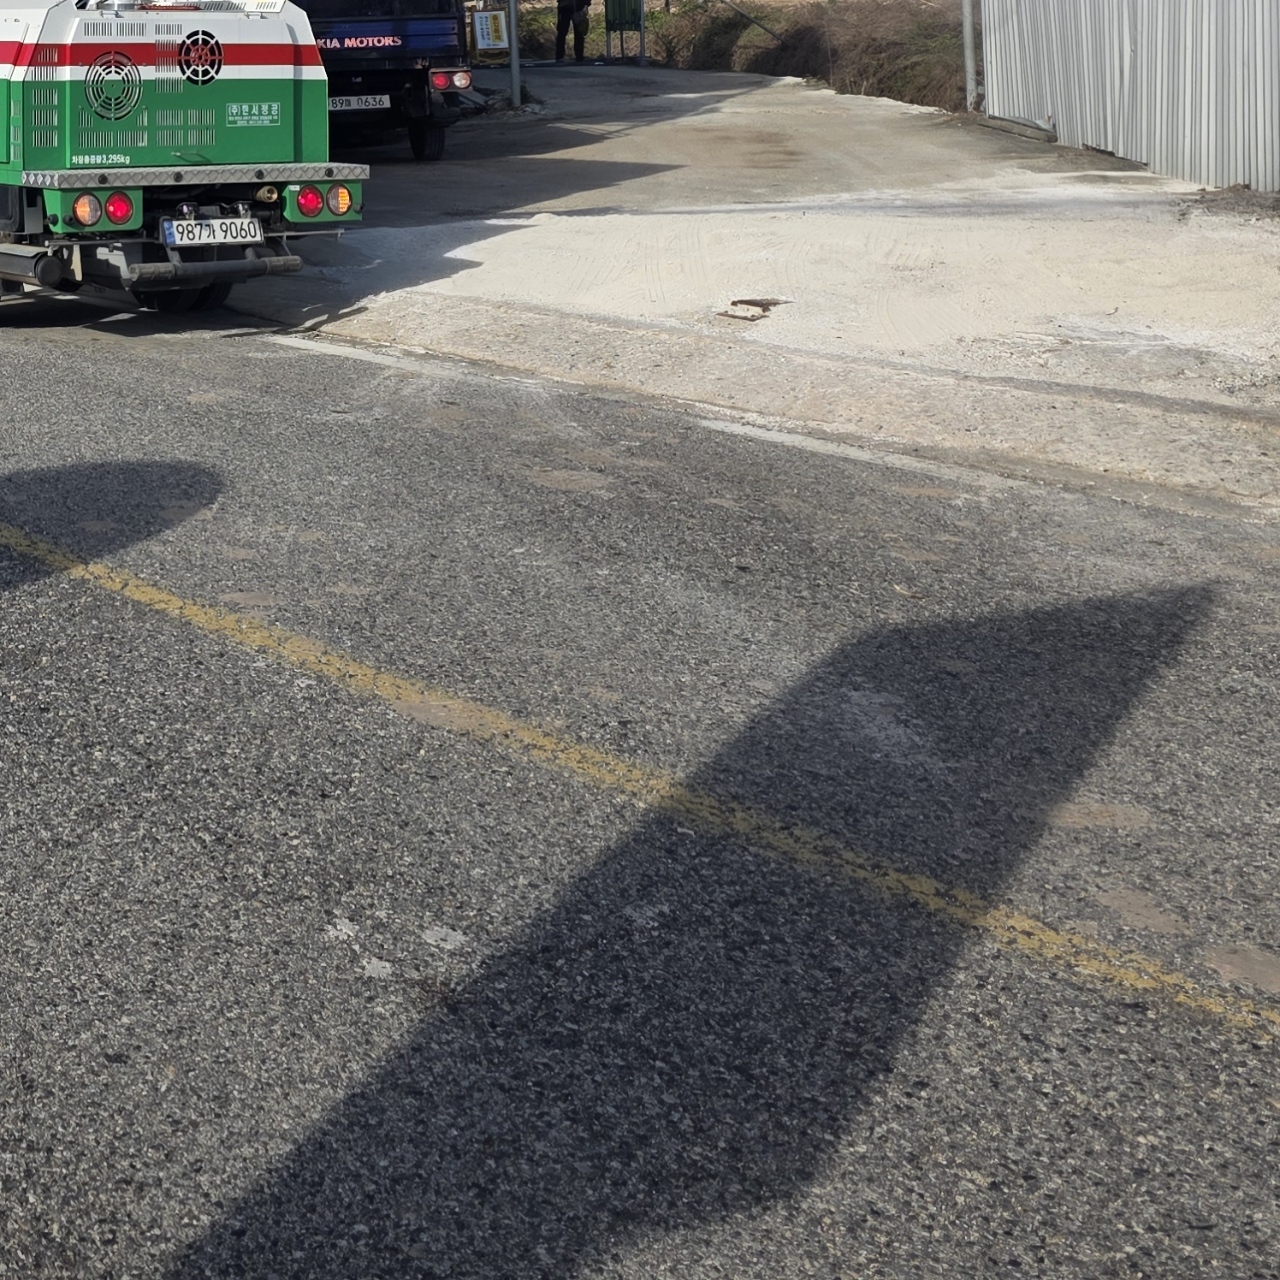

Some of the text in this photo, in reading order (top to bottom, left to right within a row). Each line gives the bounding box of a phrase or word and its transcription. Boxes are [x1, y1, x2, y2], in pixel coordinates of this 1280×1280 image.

[316, 36, 402, 49] KIA MOTORS
[357, 96, 385, 108] 0636
[175, 220, 258, 241] 987가 9060
